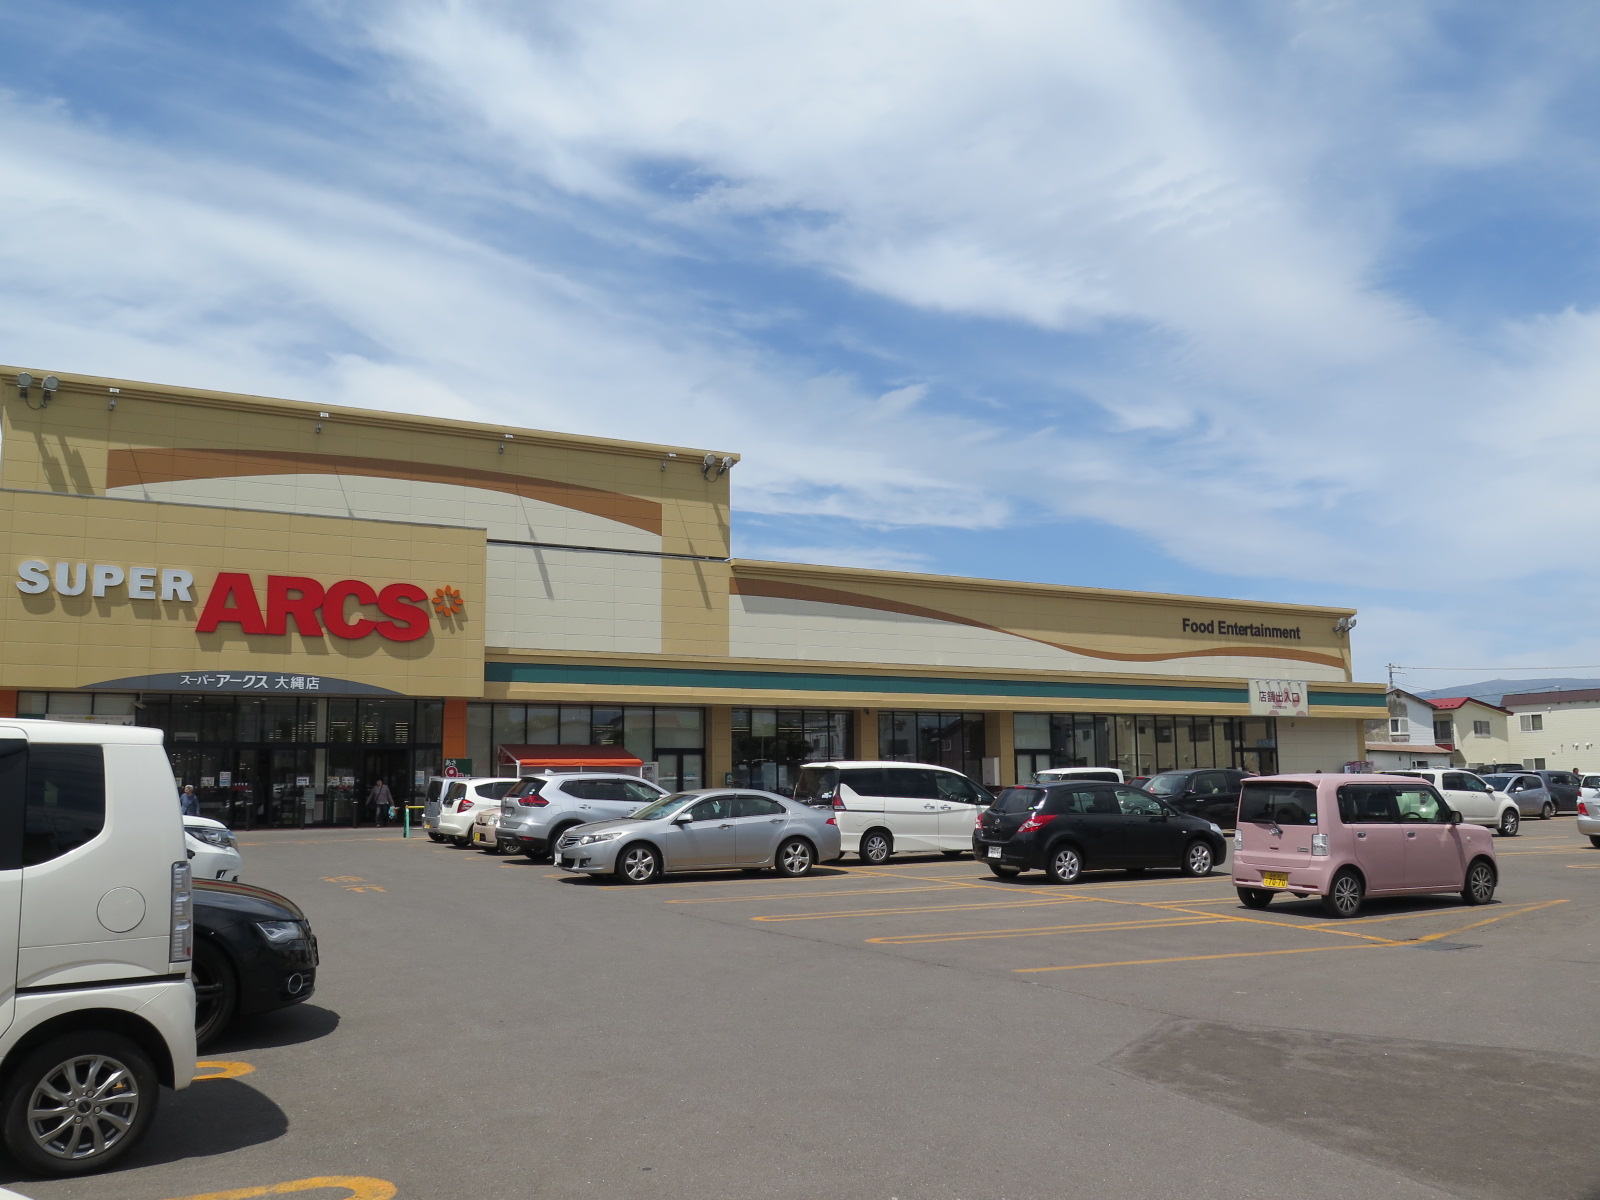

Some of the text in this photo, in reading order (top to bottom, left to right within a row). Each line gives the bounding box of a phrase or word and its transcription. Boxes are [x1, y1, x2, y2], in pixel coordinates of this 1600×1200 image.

[15, 560, 430, 642] SUPER ARCS
[1182, 617, 1301, 639] Food Entertainment
[180, 674, 320, 690] スーパーアークス 大縄店
[1258, 690, 1300, 703] 店舗出入口
